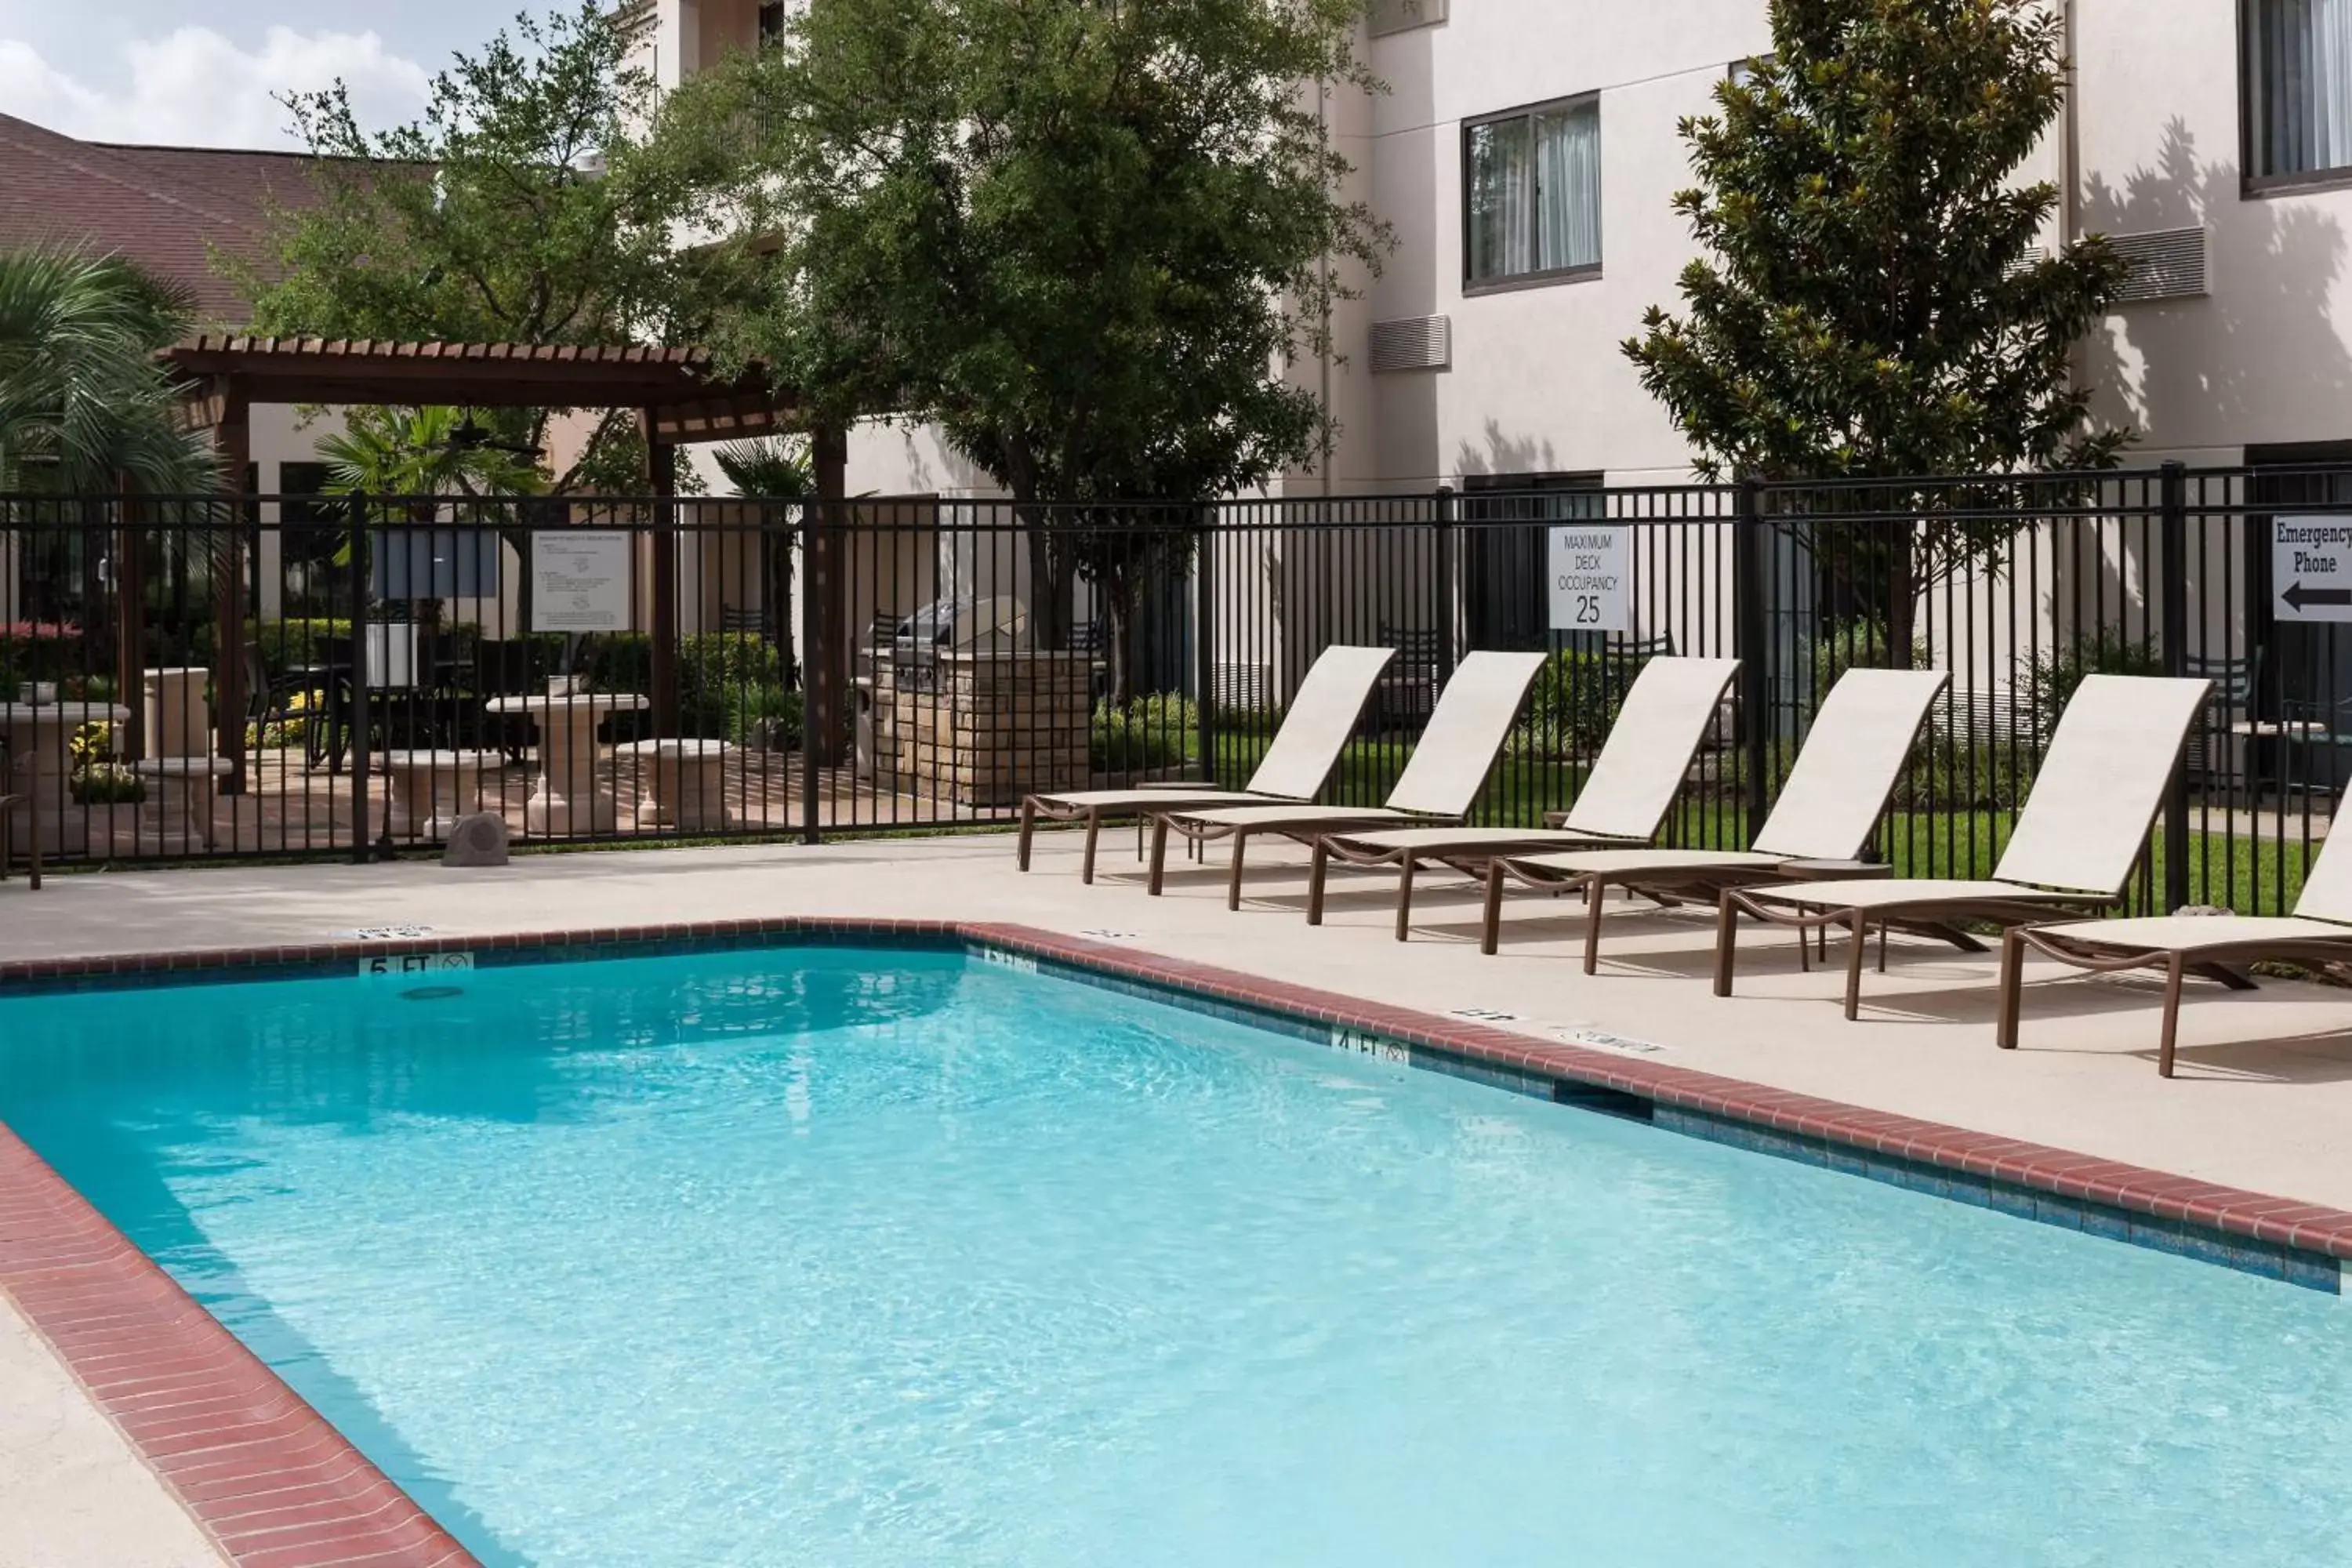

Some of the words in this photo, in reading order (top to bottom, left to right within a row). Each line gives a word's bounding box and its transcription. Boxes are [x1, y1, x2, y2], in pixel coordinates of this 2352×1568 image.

[1564, 534, 1612, 550] MAXIMUM
[2277, 522, 2352, 549] Emergency
[1575, 554, 1601, 570] DECK
[2294, 551, 2337, 573] Phone
[1558, 575, 1618, 590] OCCUPANCY
[1577, 595, 1600, 623] 25
